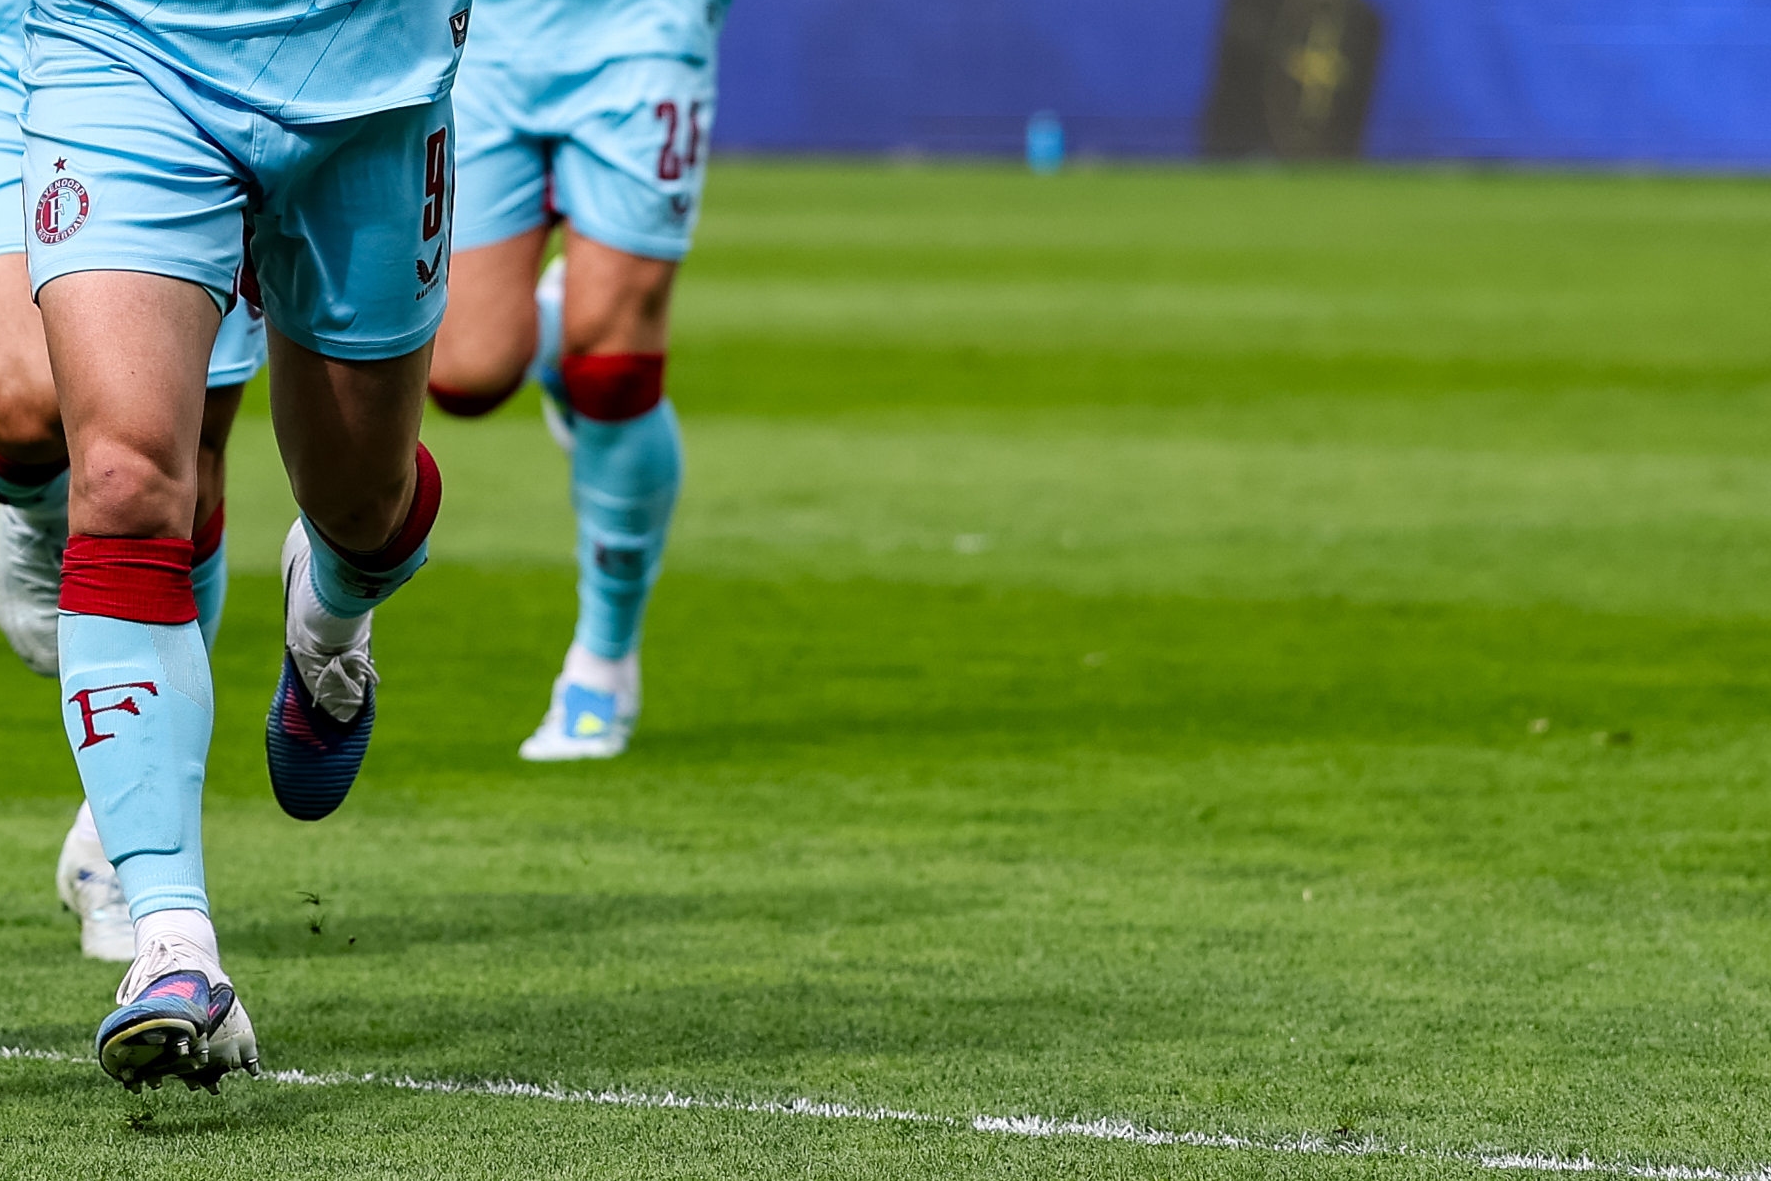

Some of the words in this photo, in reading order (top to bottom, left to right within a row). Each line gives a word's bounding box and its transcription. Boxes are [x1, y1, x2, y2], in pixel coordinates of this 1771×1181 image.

[48, 191, 70, 230] F
[423, 127, 446, 242] 9
[69, 681, 158, 751] F
